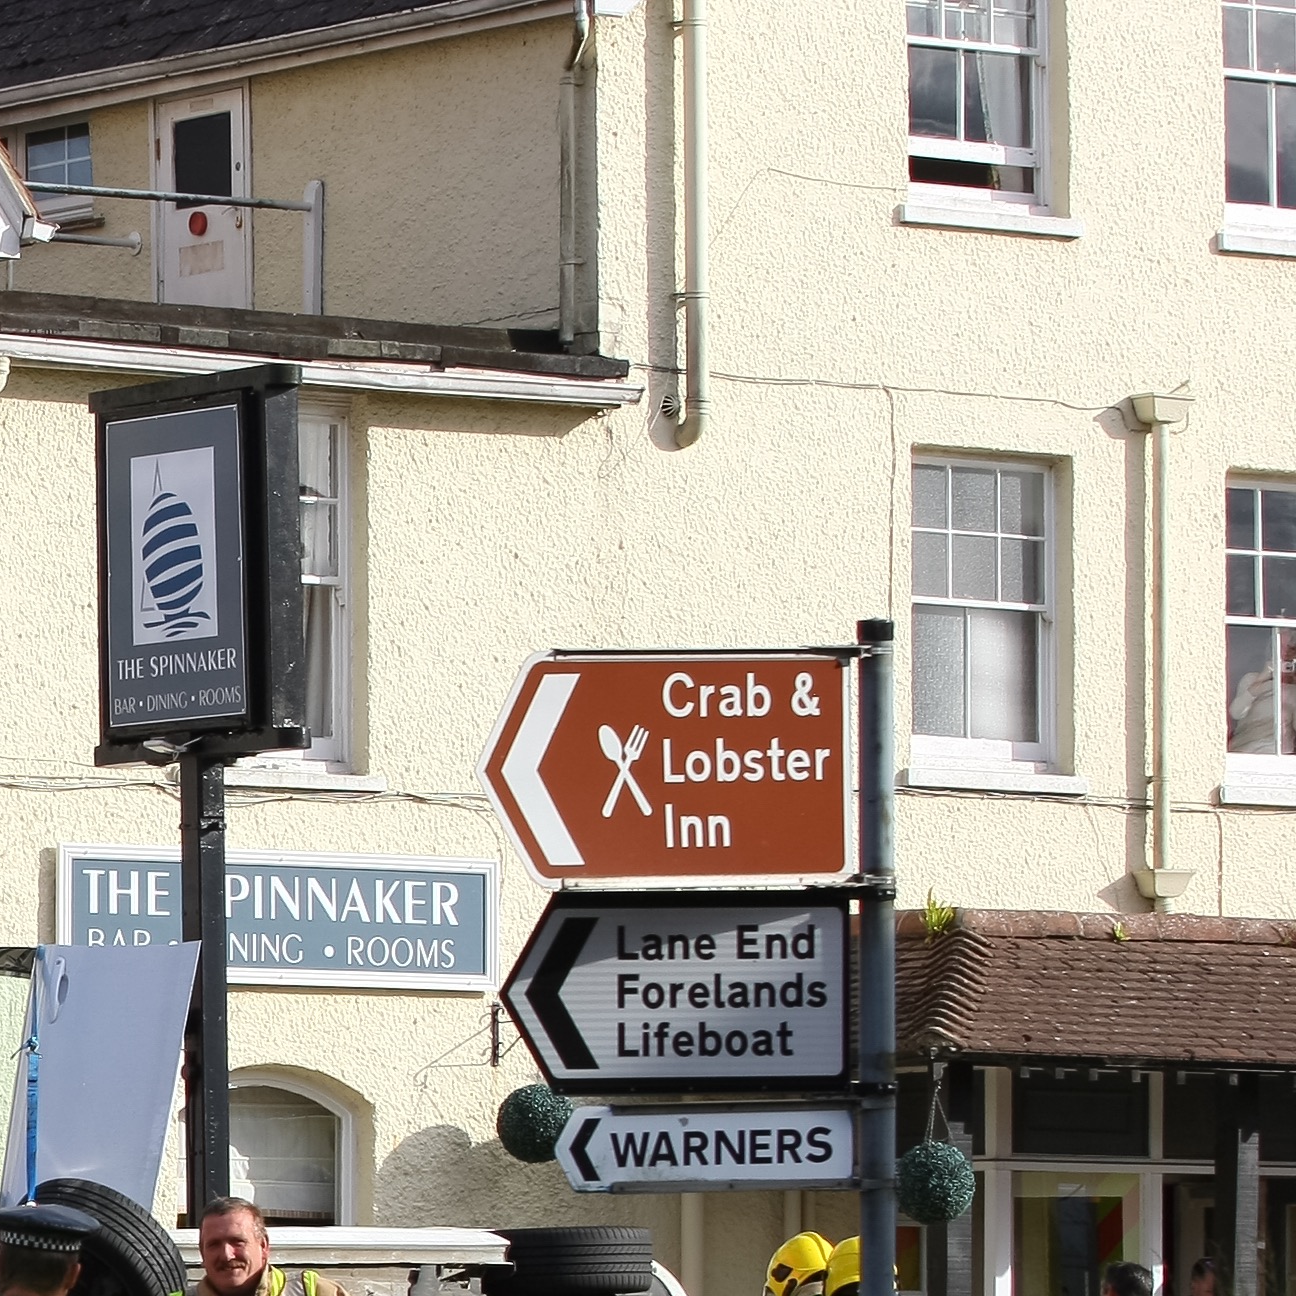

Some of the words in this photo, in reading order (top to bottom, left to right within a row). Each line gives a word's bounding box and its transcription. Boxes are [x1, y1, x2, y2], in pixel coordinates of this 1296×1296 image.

[117, 657, 145, 681] THE
[150, 647, 237, 678] SPINNAKER
[114, 697, 136, 715] BAR
[147, 691, 188, 712] DINING
[199, 685, 242, 707] ROOMS
[662, 671, 772, 718] Crab
[790, 671, 821, 717] &
[663, 737, 831, 783] Lobster
[664, 803, 731, 848] Inn
[81, 869, 171, 917] THE
[225, 873, 459, 926] PINNAKER
[229, 931, 304, 964] NING
[346, 935, 455, 969] ROOMS
[617, 925, 716, 961] Lane
[736, 924, 816, 960] End
[617, 972, 828, 1010] Forelands
[617, 1021, 794, 1058] Lifeboat
[610, 1126, 833, 1168] WARNERS
